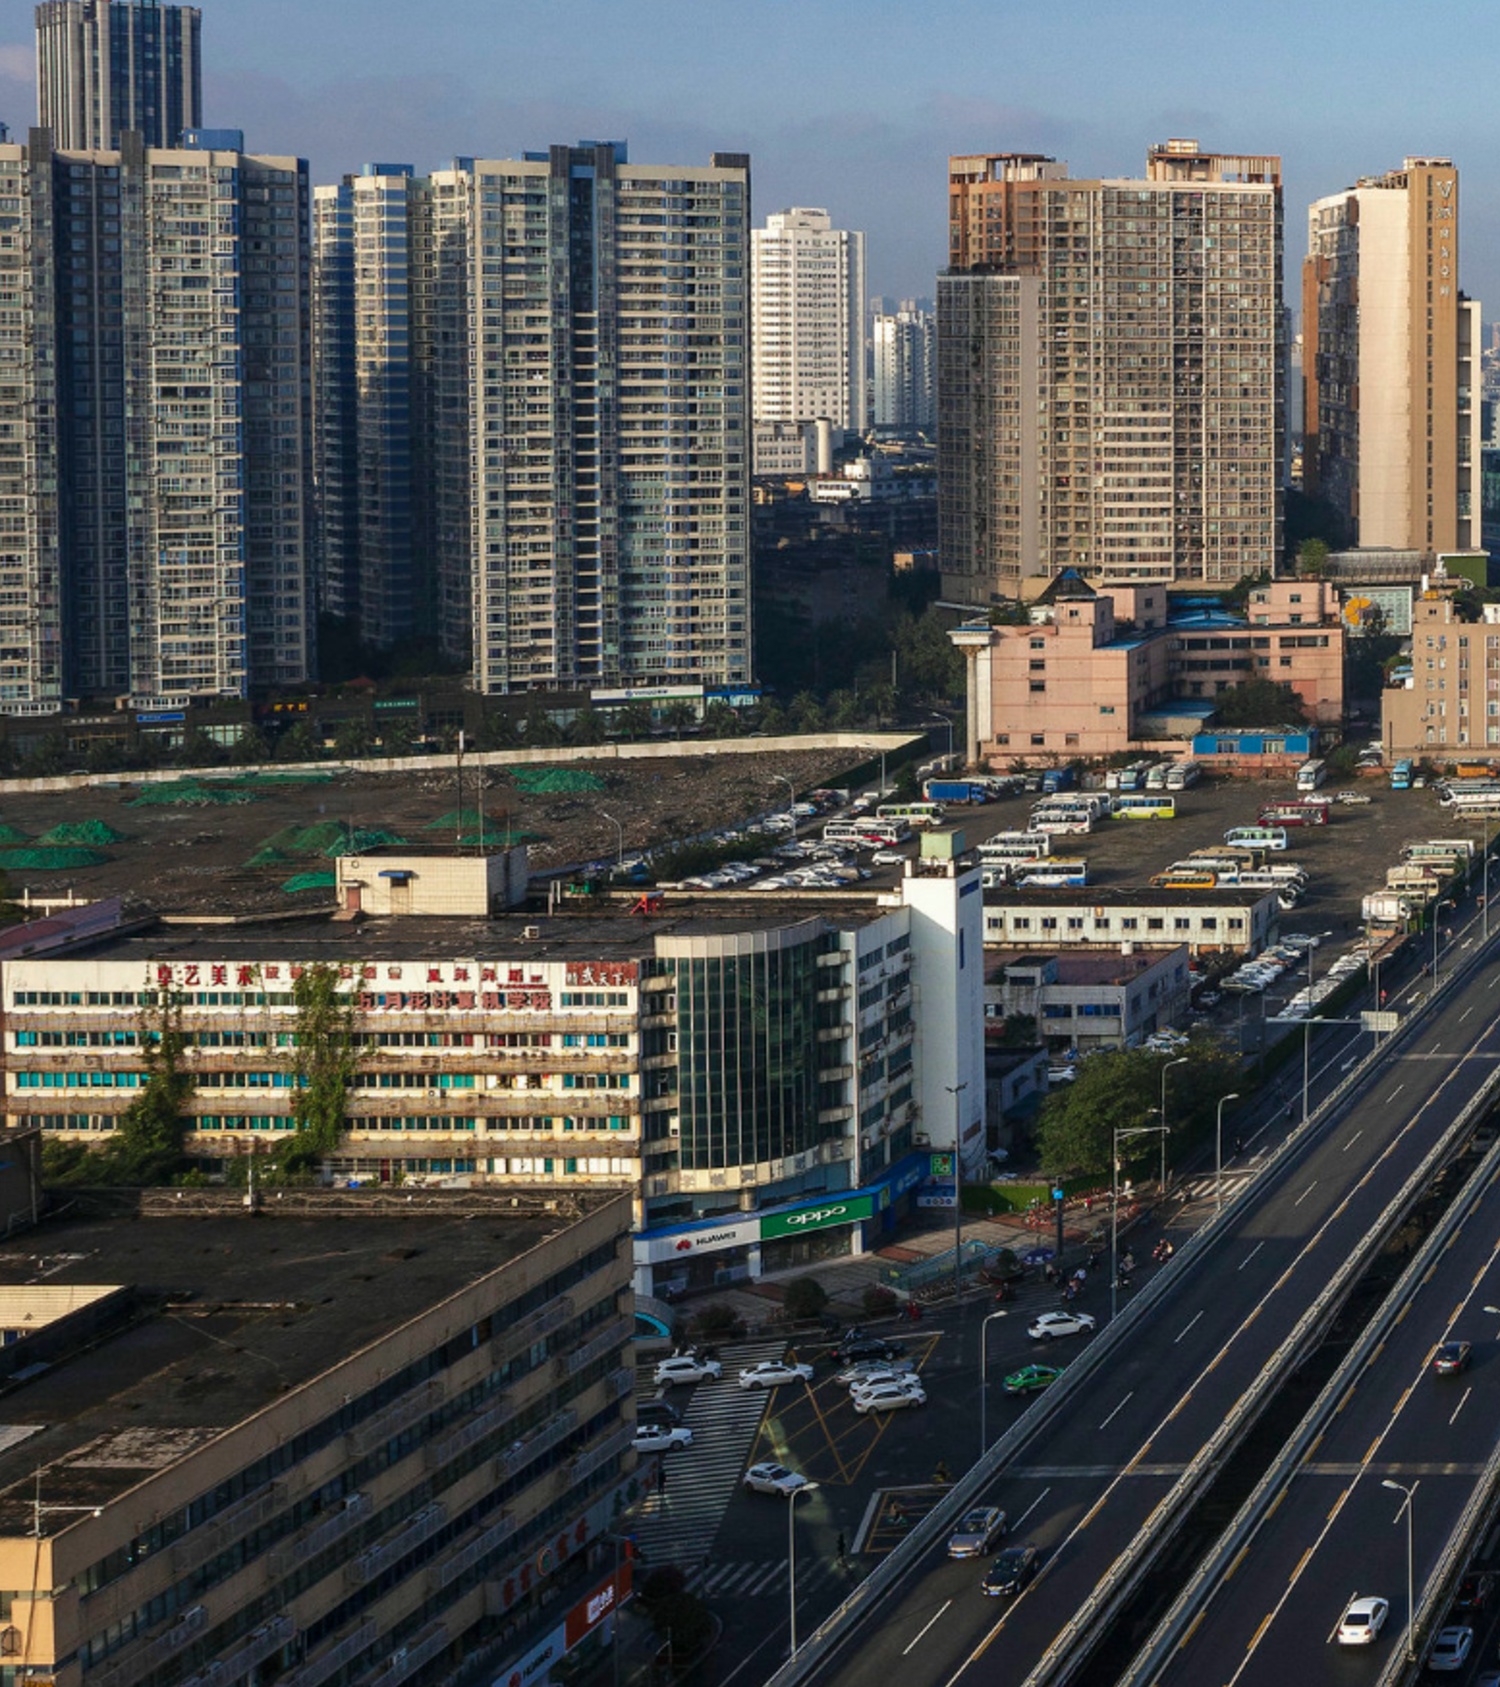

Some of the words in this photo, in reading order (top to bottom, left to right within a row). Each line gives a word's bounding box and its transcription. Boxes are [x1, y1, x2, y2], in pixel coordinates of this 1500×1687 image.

[360, 990, 552, 1011] 五月花计算机学校
[696, 1231, 737, 1246] HUAWEI
